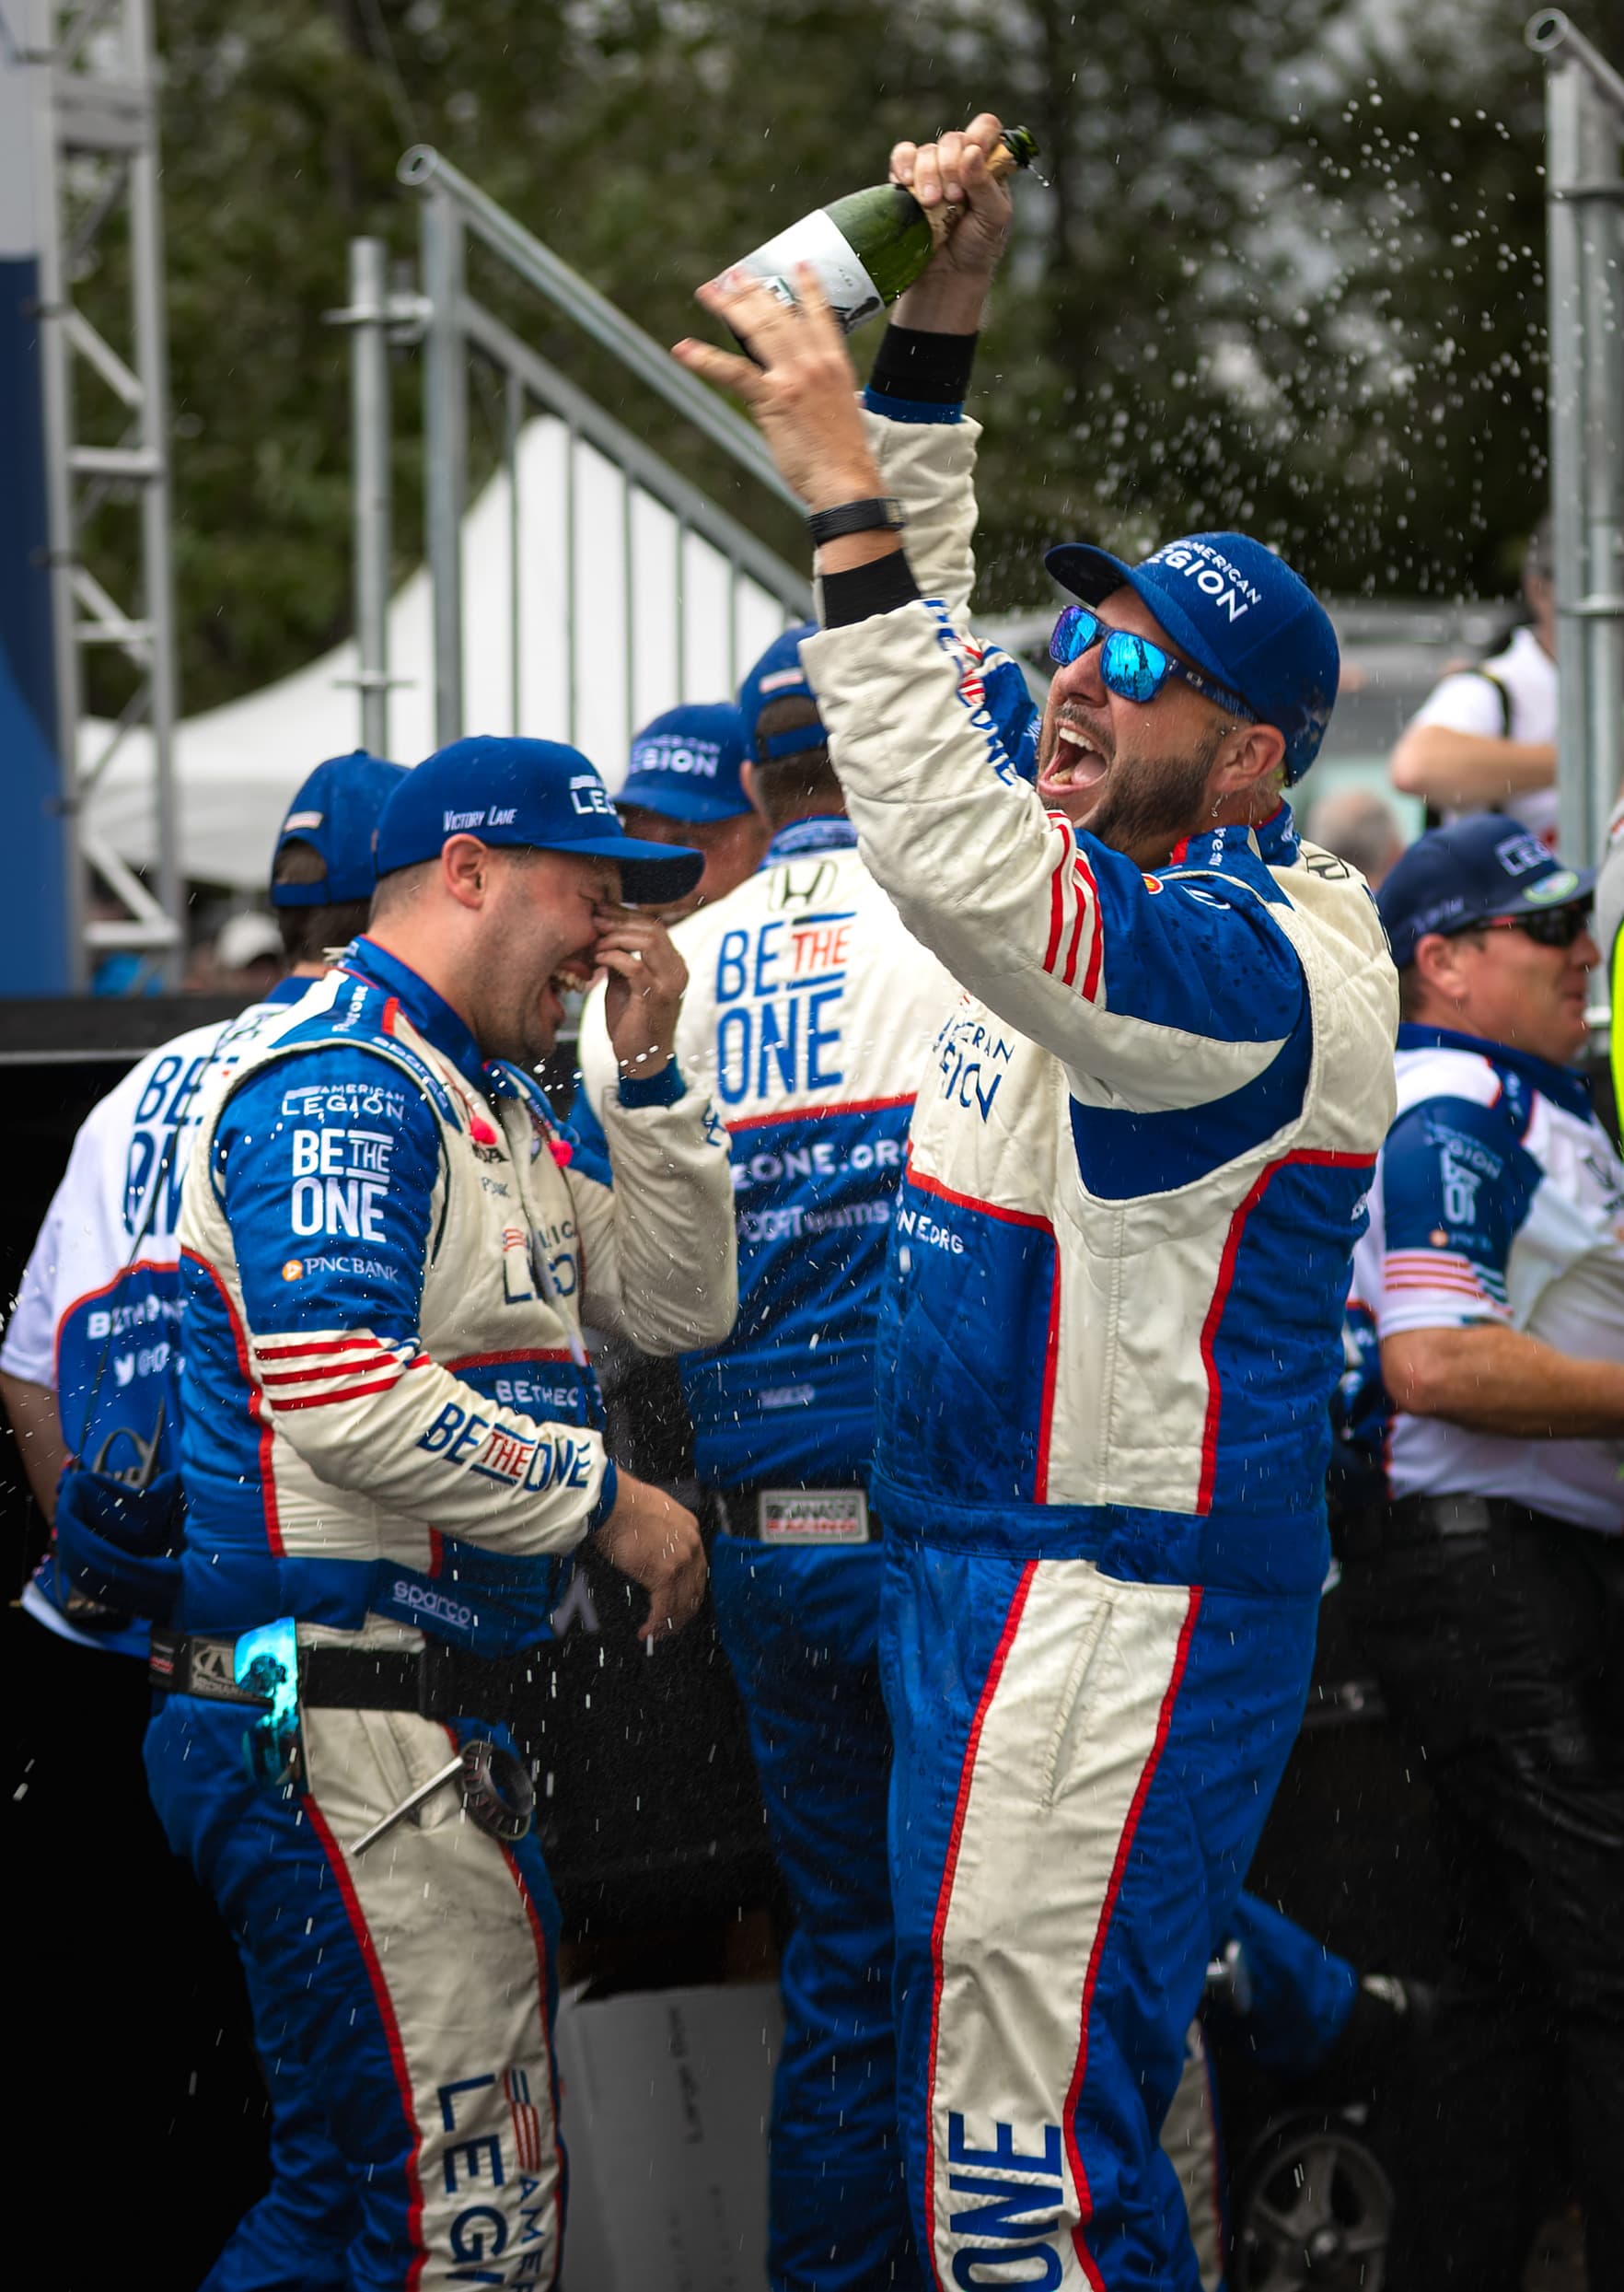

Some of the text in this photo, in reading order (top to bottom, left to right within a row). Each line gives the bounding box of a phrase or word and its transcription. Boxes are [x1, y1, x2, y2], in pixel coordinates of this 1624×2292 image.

[716, 921, 853, 1005] BE THE
[716, 986, 844, 1105] ONE
[282, 1095, 405, 1122] LEGION
[321, 1083, 405, 1102] AMERICAN
[292, 1128, 393, 1177] BE THE
[291, 1176, 389, 1243] ONE
[416, 1402, 591, 1493] BE THE ONE
[392, 1579, 471, 1624] sparco
[947, 2112, 1064, 2292] ONE
